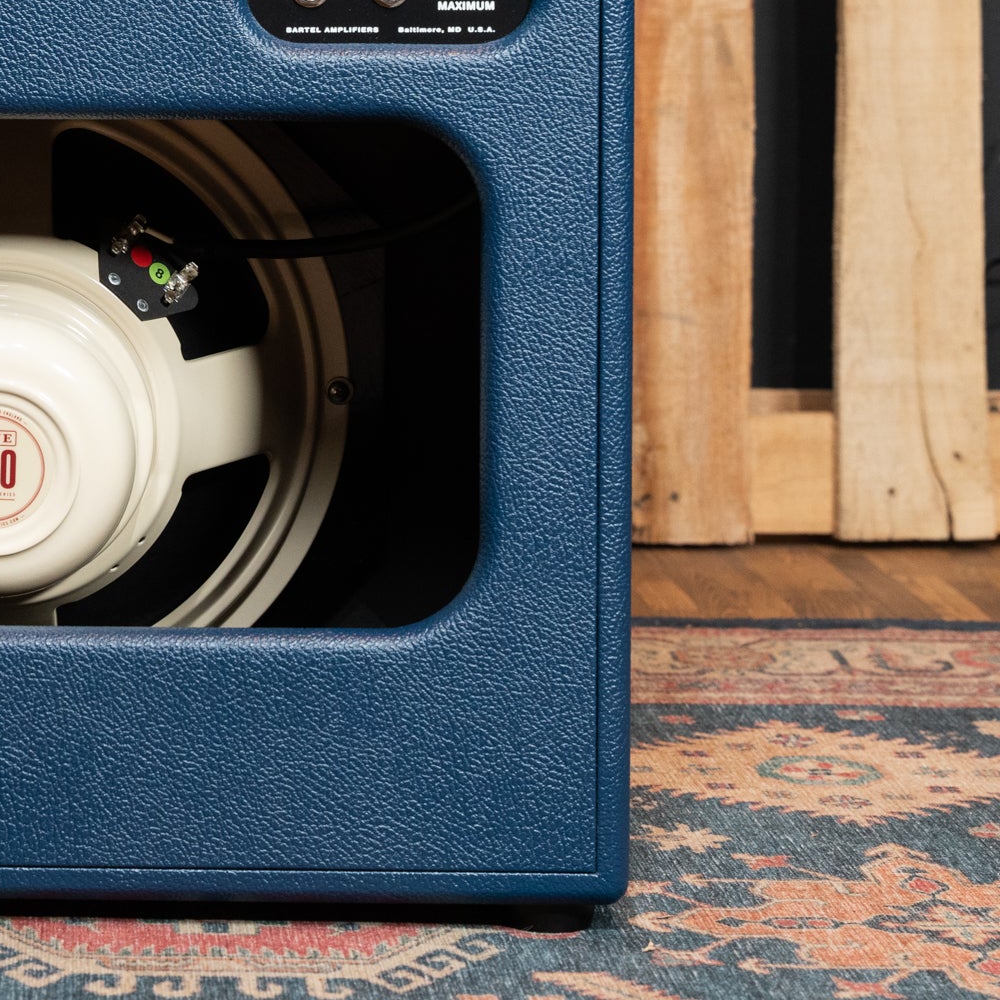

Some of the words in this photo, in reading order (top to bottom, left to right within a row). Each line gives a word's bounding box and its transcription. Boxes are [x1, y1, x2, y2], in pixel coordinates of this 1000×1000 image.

[437, 1, 495, 11] MAXIMUM
[398, 26, 445, 34] Baltimore,
[155, 268, 164, 279] 8
